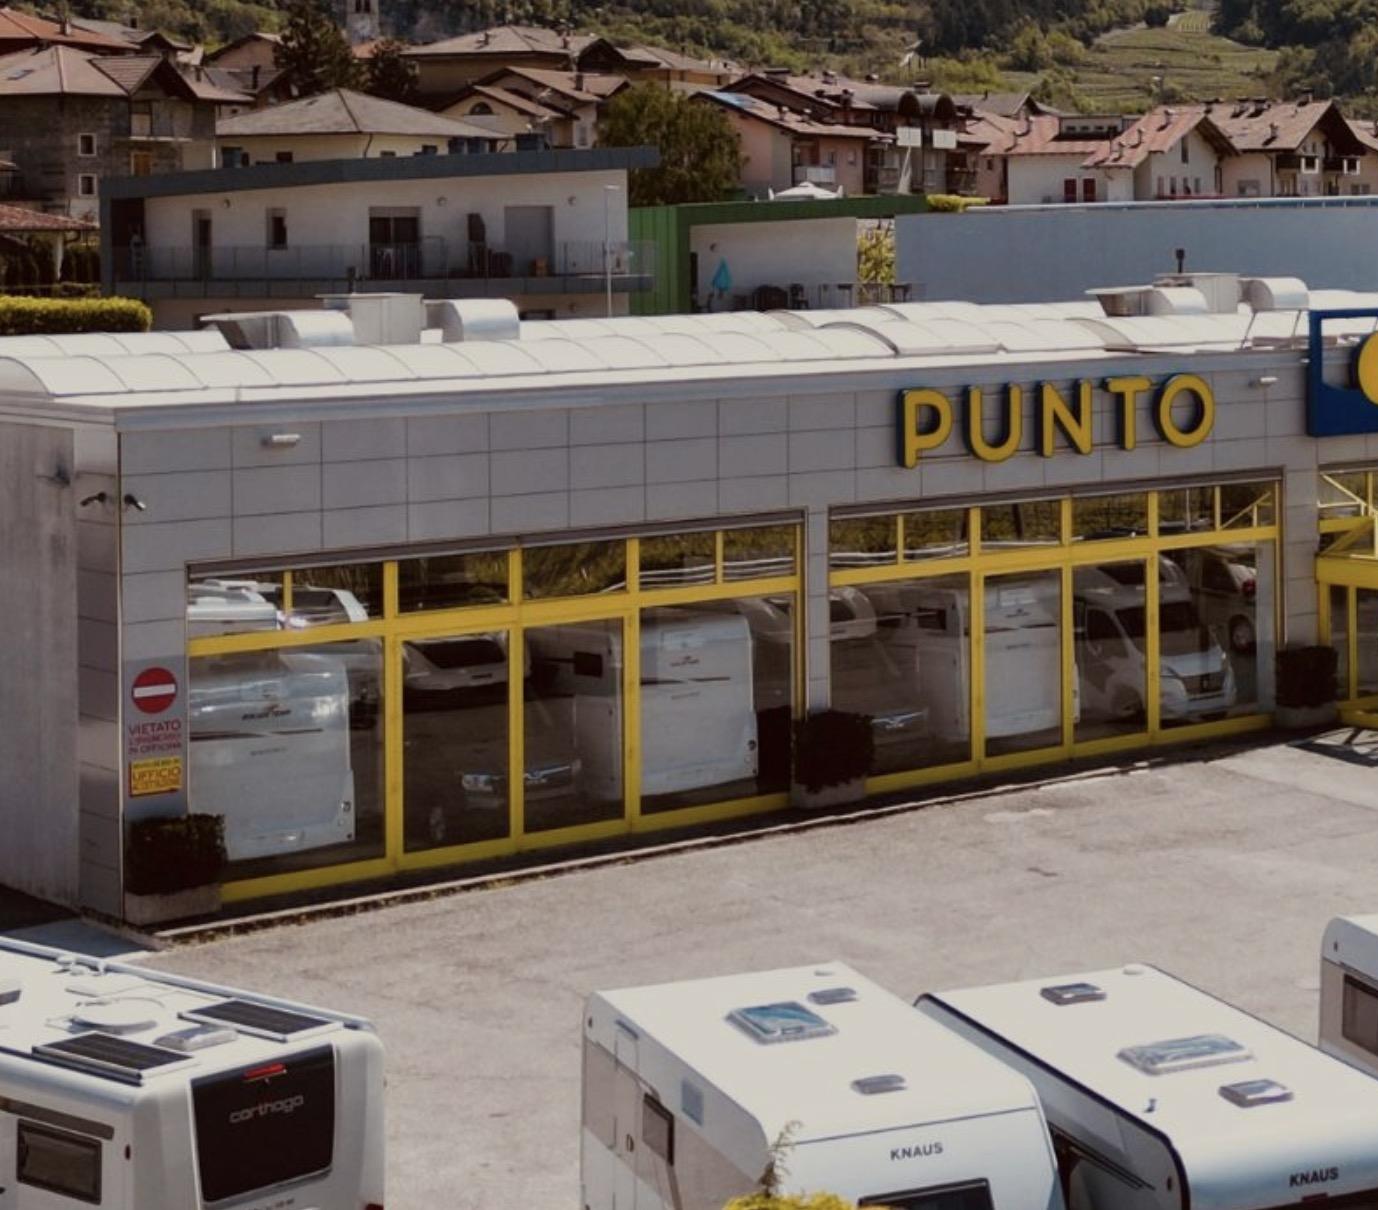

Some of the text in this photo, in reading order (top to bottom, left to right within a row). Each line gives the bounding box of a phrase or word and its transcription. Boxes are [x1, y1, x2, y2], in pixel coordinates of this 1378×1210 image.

[898, 372, 1215, 469] PUNTO
[128, 718, 181, 736] VIETATO
[133, 766, 182, 781] UFFICIO
[229, 1095, 304, 1123] carthago
[890, 1141, 944, 1161] KNAUS
[1289, 1166, 1339, 1187] KNAUS
